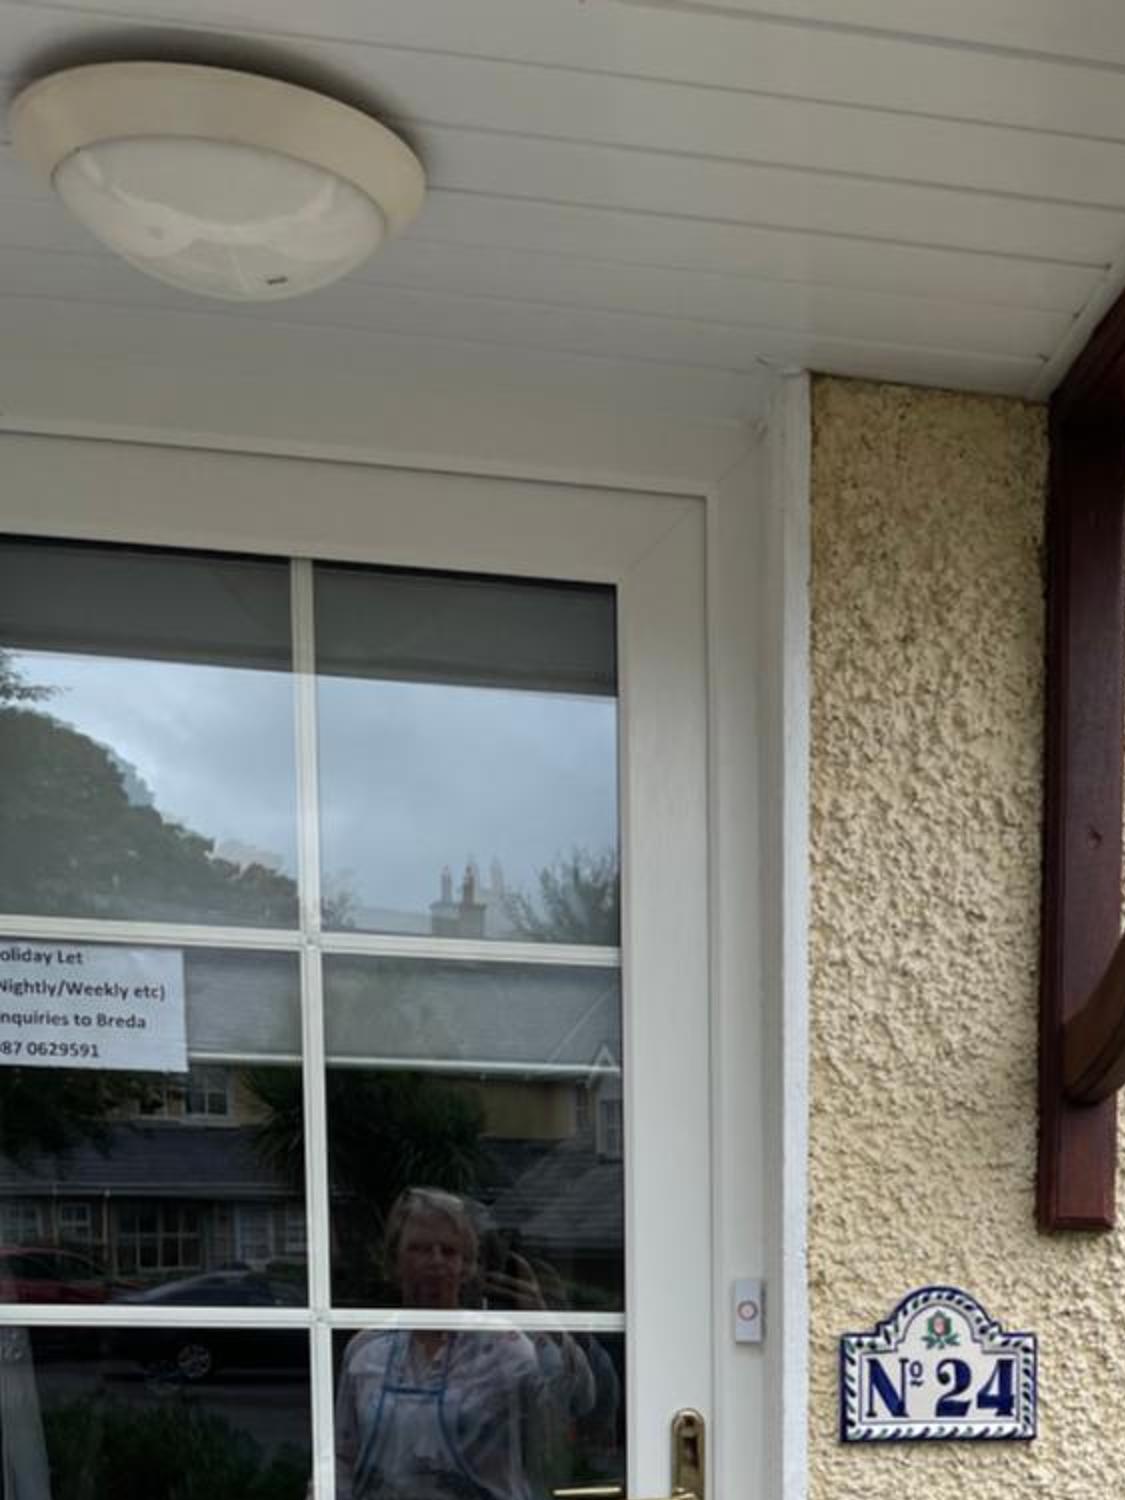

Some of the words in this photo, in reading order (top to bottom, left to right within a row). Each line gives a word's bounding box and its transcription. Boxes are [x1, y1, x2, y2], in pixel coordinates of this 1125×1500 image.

[0, 947, 52, 966] oliday
[57, 950, 83, 965] Let
[0, 978, 129, 1000] Nightly/Weekly
[134, 984, 166, 1002] etc)
[0, 1010, 69, 1028] nquiries
[74, 1014, 92, 1027] to
[97, 1012, 147, 1029] Breda
[0, 1039, 22, 1055] 87
[27, 1040, 100, 1058] 0629591
[935, 1357, 1015, 1418] 24
